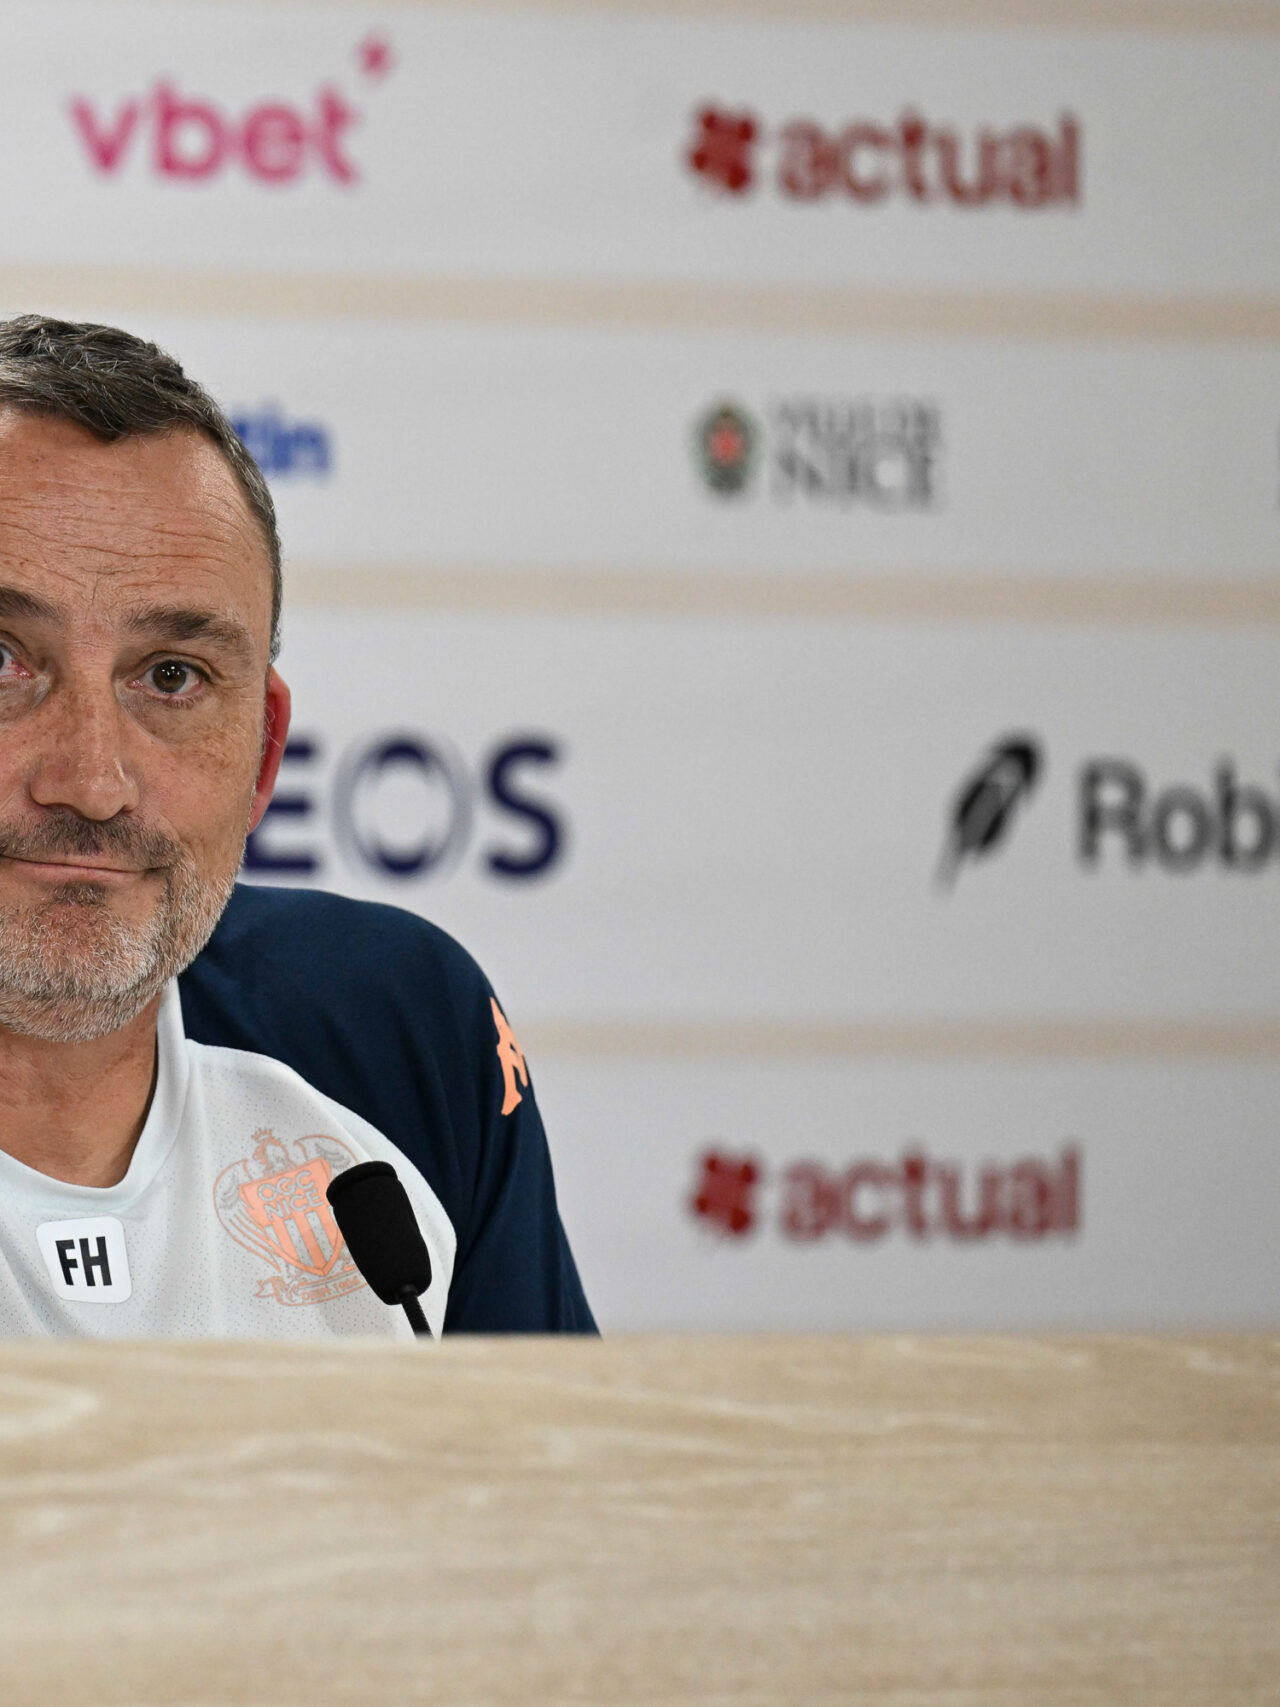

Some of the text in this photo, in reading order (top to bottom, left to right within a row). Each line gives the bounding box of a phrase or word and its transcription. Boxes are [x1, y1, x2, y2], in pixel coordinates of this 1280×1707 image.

[70, 78, 360, 186] vbet
[778, 108, 1080, 206] actual
[244, 738, 566, 878] EOS
[257, 1170, 315, 1202] OGC
[264, 1190, 324, 1219] NICE
[780, 1144, 1082, 1244] actual
[55, 1236, 113, 1287] FH
